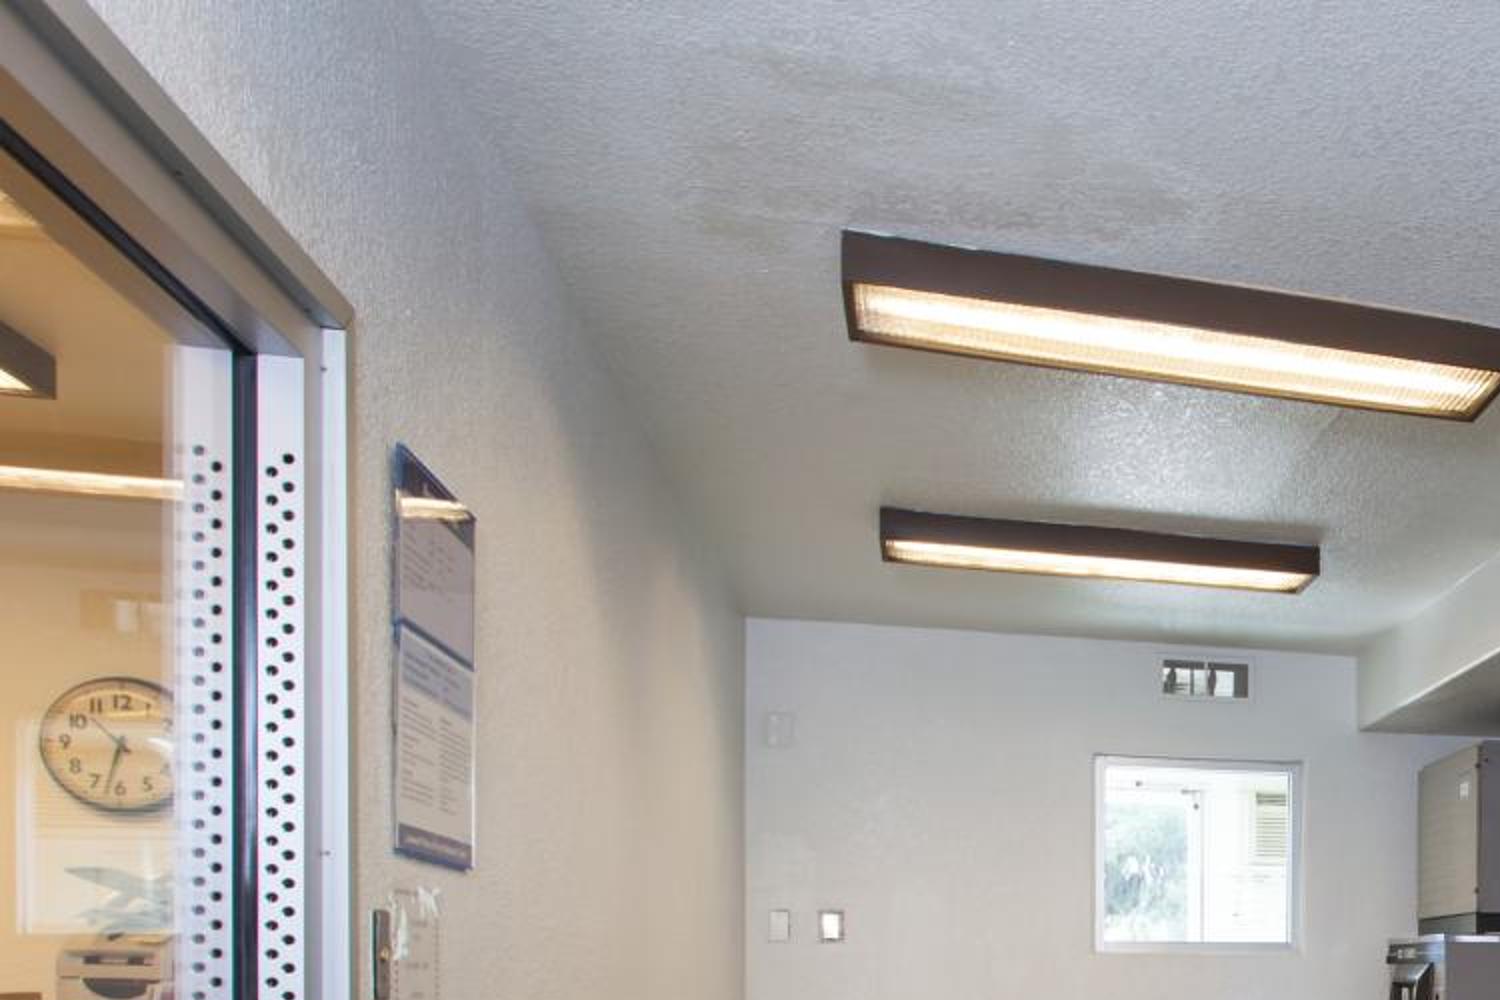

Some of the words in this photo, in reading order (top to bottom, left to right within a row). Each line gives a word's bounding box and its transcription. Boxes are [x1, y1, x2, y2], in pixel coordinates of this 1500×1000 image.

[90, 697, 102, 713] 11
[113, 694, 133, 710] 12
[69, 713, 87, 729] 10
[59, 733, 71, 749] 9
[69, 757, 81, 774] 8
[90, 773, 101, 788] 7
[114, 781, 126, 796] 6
[143, 776, 153, 792] 5
